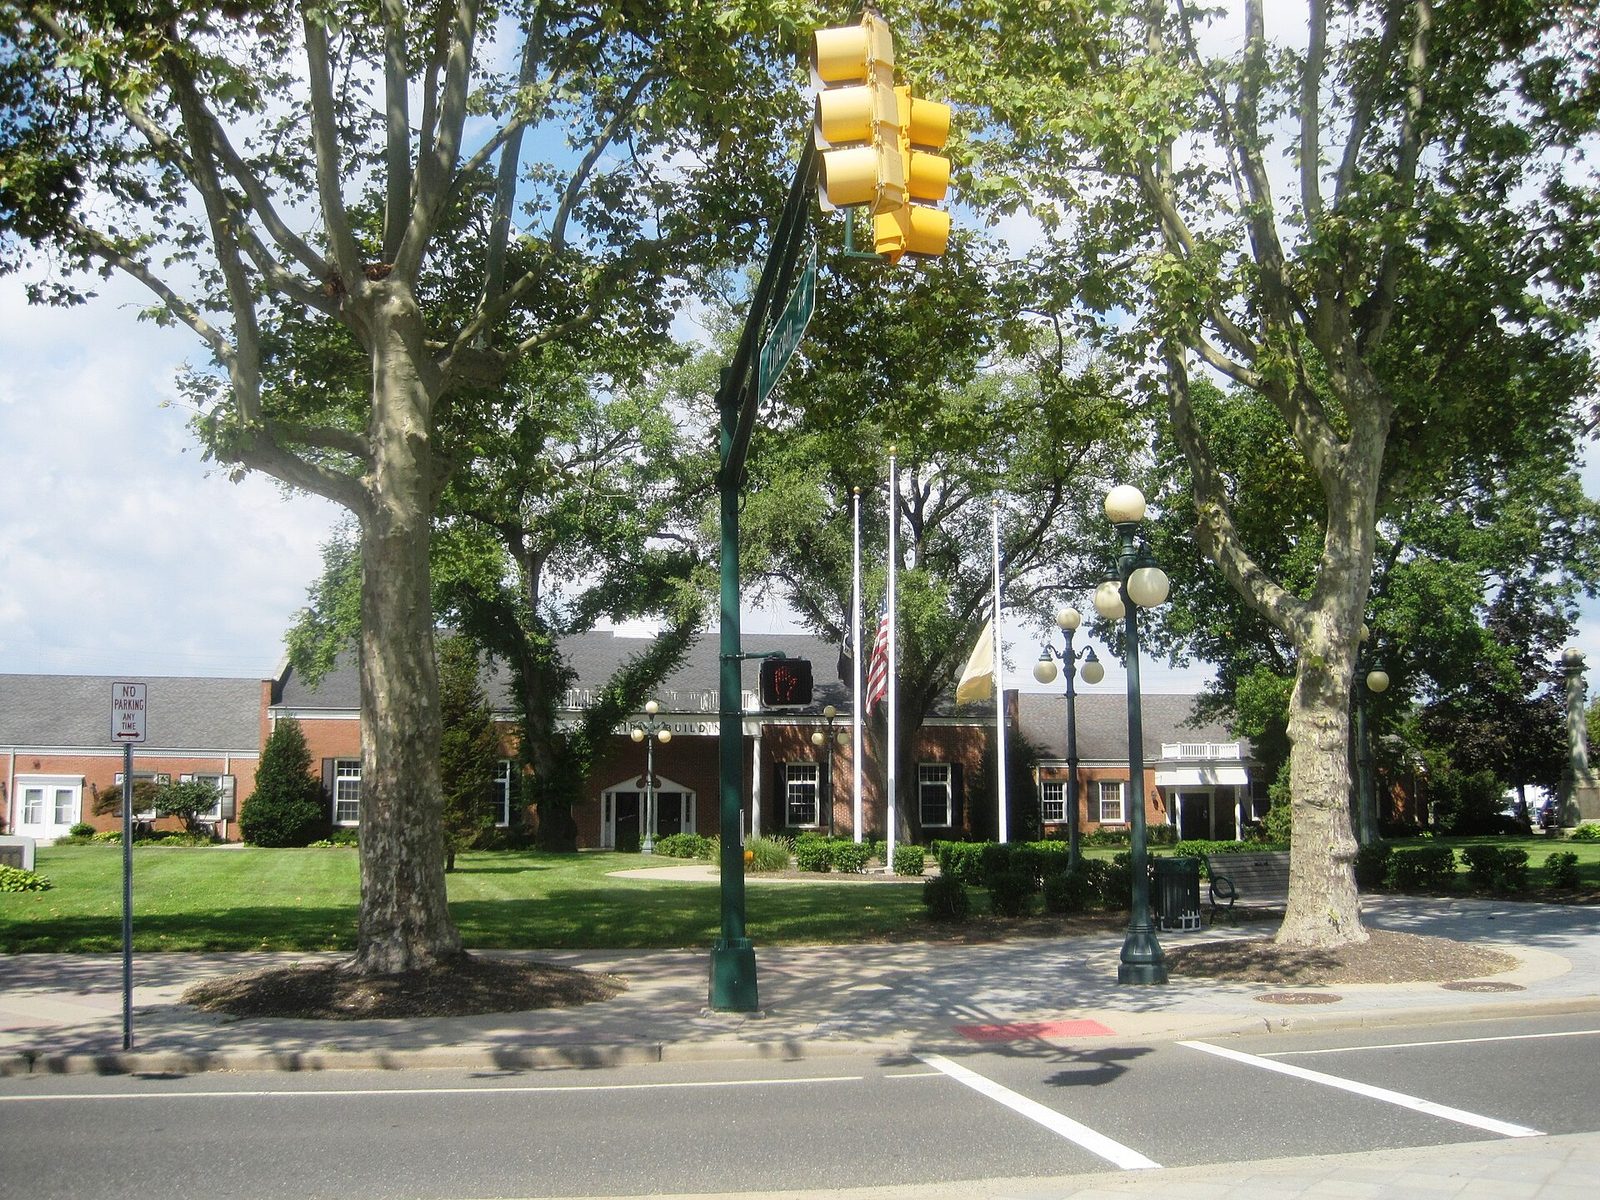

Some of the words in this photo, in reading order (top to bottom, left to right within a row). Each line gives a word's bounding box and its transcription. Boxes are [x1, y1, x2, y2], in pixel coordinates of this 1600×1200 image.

[122, 686, 136, 697] NO
[114, 699, 144, 711] PARKING
[122, 713, 136, 721] ANY
[121, 722, 137, 730] TIME
[665, 723, 721, 733] BUILDIN
